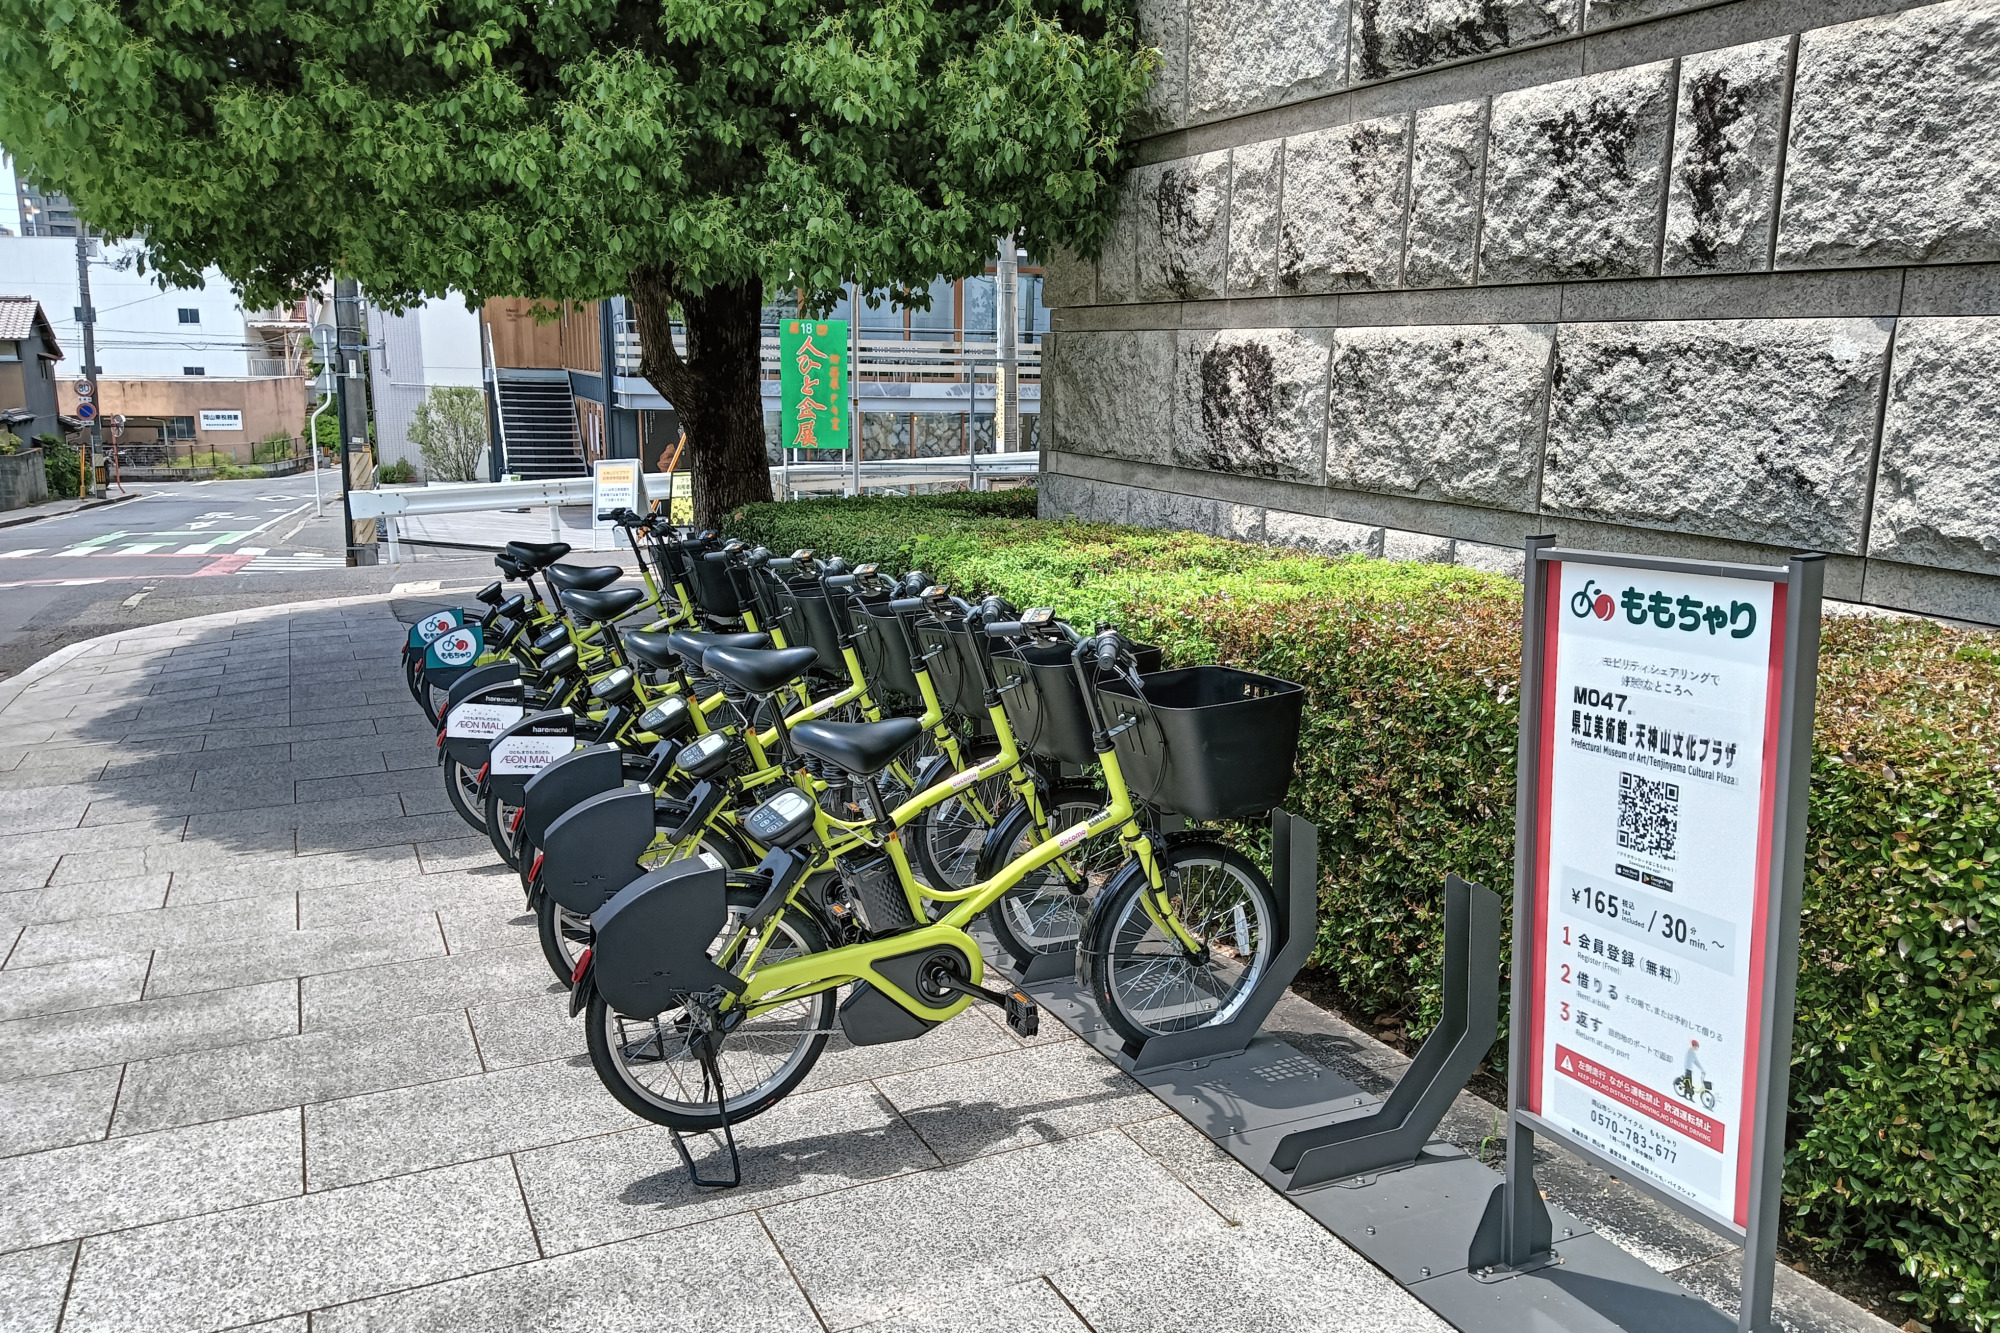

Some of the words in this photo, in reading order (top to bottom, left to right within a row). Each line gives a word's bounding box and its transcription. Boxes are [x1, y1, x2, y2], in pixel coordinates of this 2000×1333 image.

[793, 335, 829, 448] 人ひと会展
[1620, 586, 1757, 639] ももちゃり
[441, 652, 472, 660] ももちゃり
[1603, 657, 1720, 686] モビリティシェアリングで
[482, 721, 506, 730] MALL
[1571, 709, 1738, 769] 県立美術館・天神山文化プラザ
[1571, 738, 1601, 753] Prefectural
[1603, 745, 1628, 759] Museum
[1628, 751, 1636, 761] of
[1688, 765, 1714, 780] Cultural
[1716, 771, 1737, 785] Plaza
[1059, 829, 1086, 847] docomo
[1571, 887, 1619, 918] ¥165
[1622, 899, 1635, 911] 税込
[1661, 913, 1687, 943] 30
[1690, 927, 1697, 935] 分
[1621, 915, 1645, 929] included
[1622, 908, 1631, 917] tax
[1689, 938, 1708, 951] min.
[1562, 926, 1571, 946] 1
[1577, 952, 1601, 966] Register
[1560, 964, 1571, 984] 2
[1577, 970, 1618, 1001] 借りる
[1560, 1001, 1570, 1021] 3
[1576, 1010, 1604, 1032] 返す
[1575, 1028, 1596, 1044] Return
[1604, 1044, 1615, 1054] any
[1577, 1071, 1590, 1081] KEEP
[1610, 1088, 1639, 1105] DISTRACTED
[1670, 1116, 1688, 1131] DRUNK
[1689, 1127, 1712, 1142] DRIVING
[1578, 1060, 1606, 1080] 左側走行
[1609, 1076, 1660, 1108] ながら運転禁止
[1663, 1102, 1712, 1133] 飲酒運転禁止
[1590, 1110, 1677, 1164] 0570-783-677
[1650, 1129, 1677, 1148] ももちゃり
